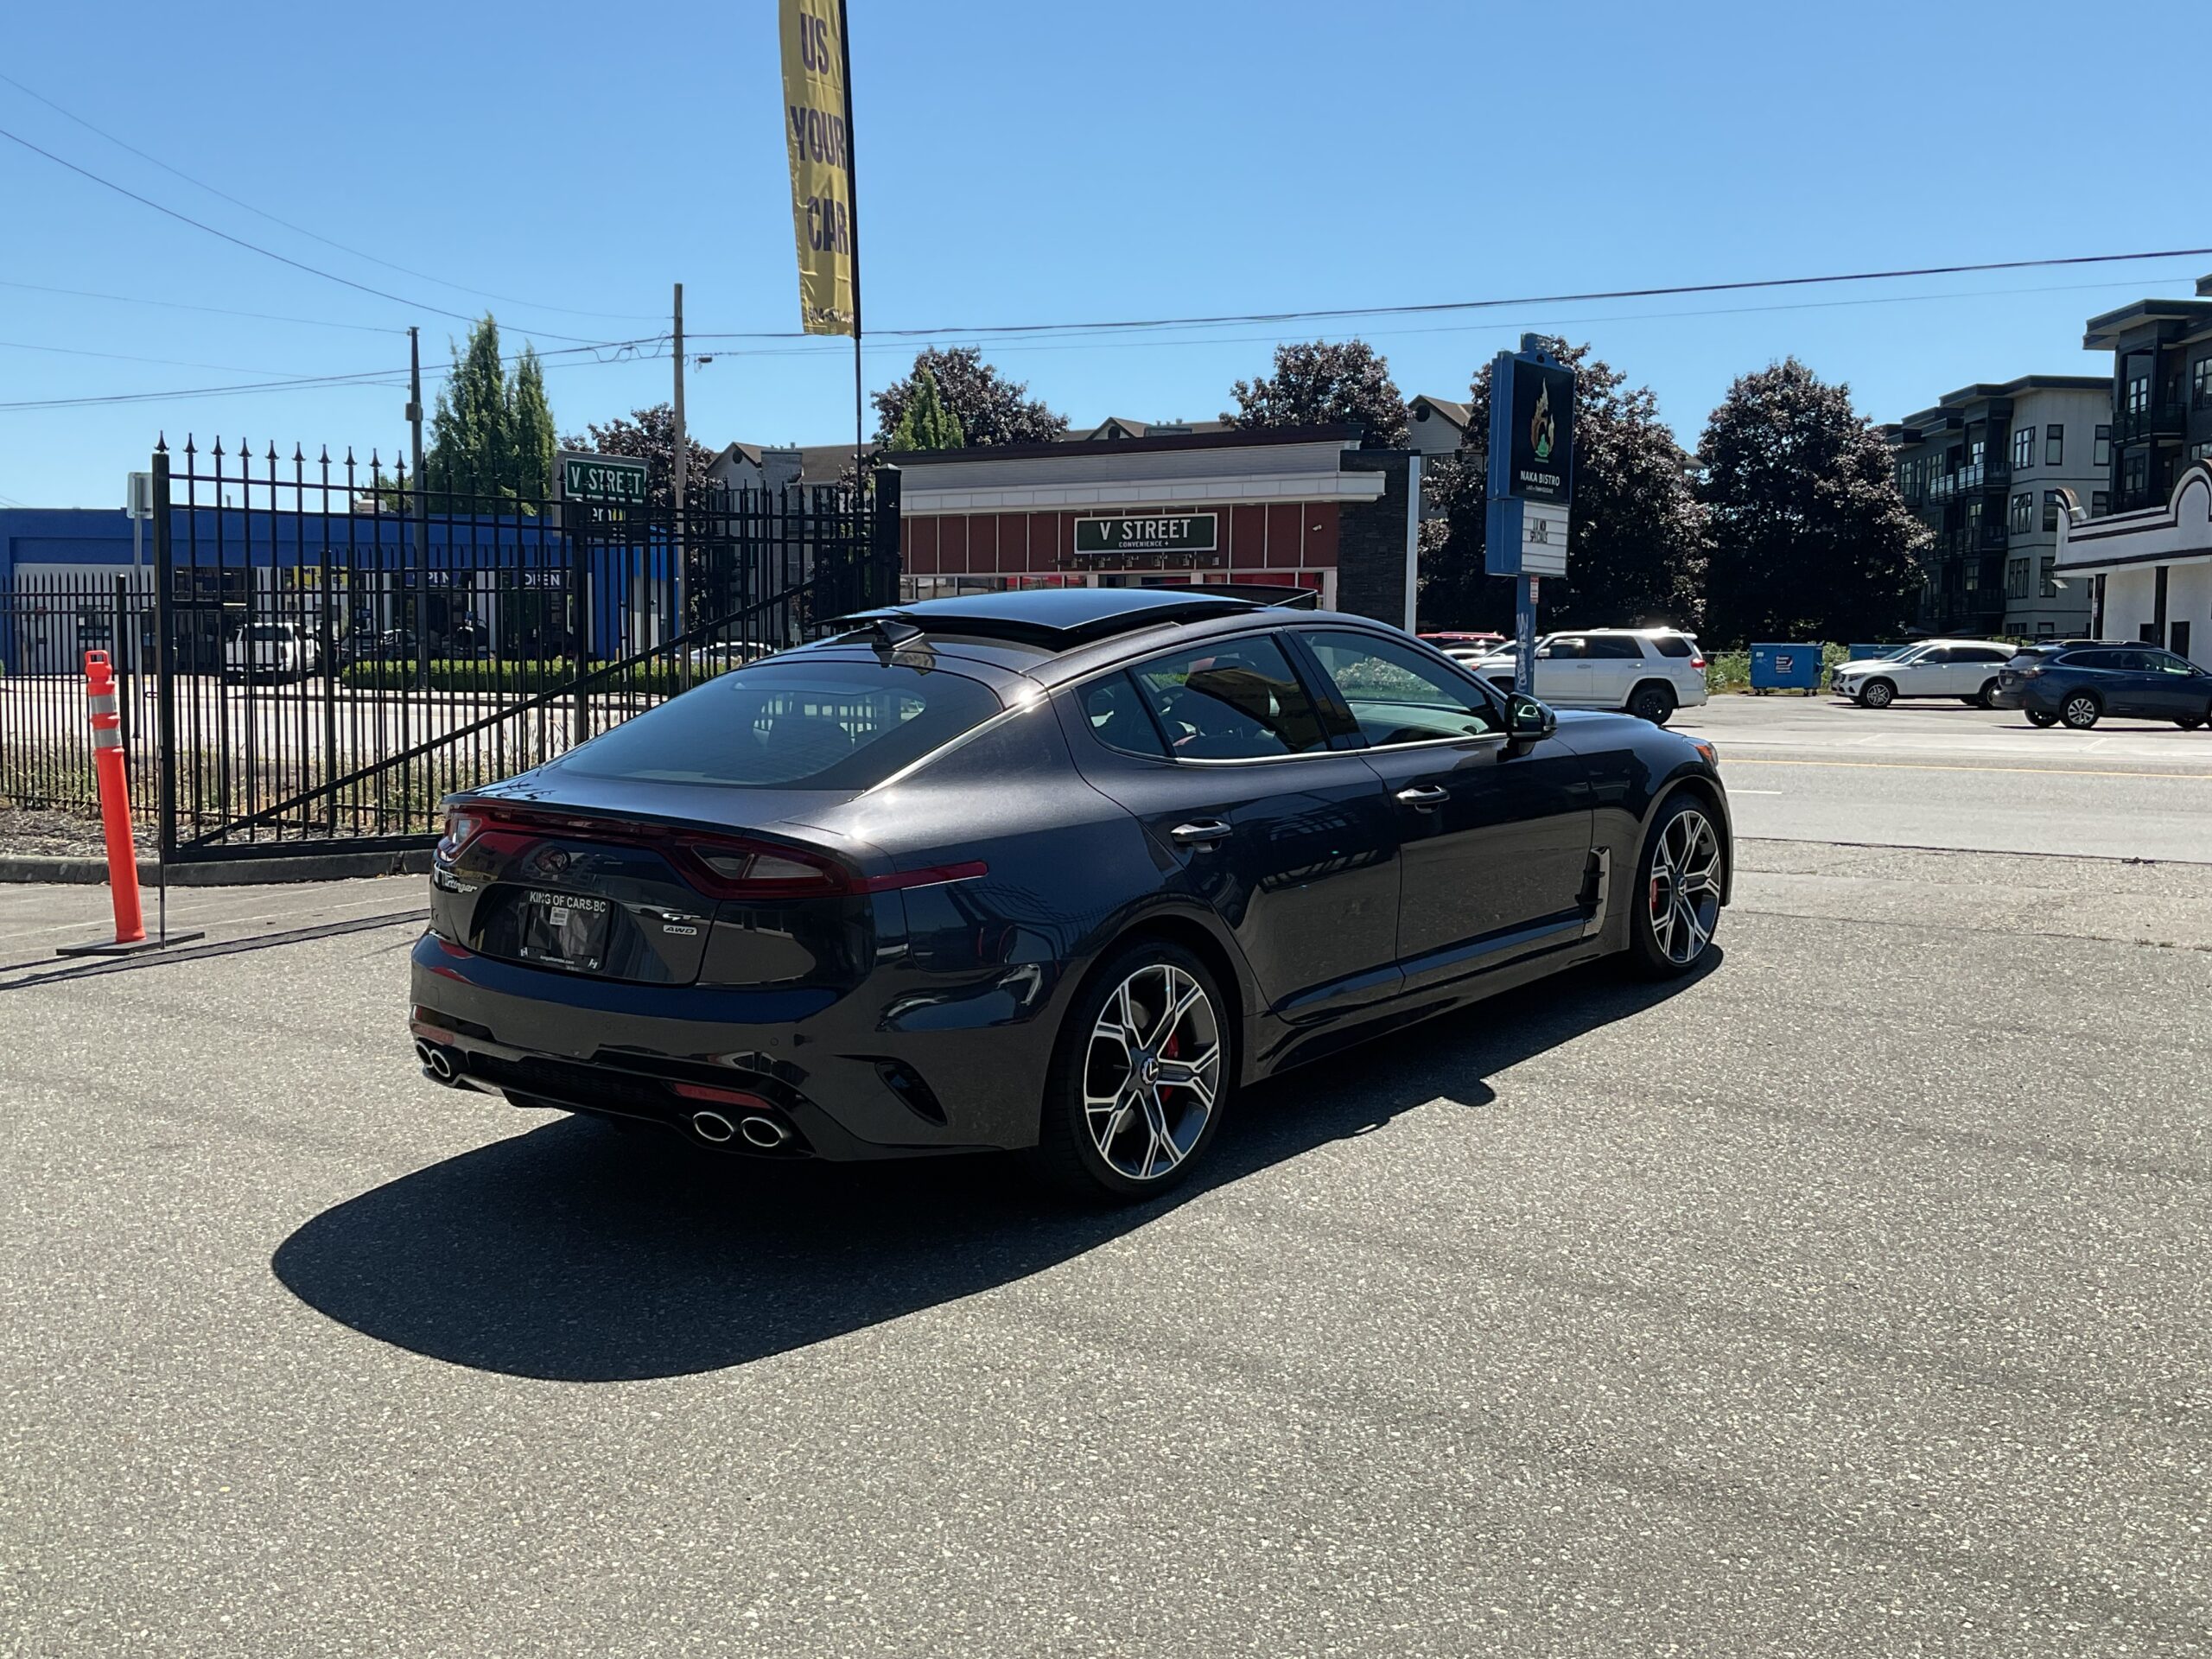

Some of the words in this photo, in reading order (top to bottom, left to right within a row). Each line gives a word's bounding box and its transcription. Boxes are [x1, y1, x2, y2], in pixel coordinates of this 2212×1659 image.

[800, 12, 830, 75] US
[790, 105, 847, 170] YOUR
[806, 195, 849, 256] CAR
[570, 467, 581, 488] V
[1520, 470, 1538, 483] NAKA
[1538, 473, 1560, 486] BISTRO
[1100, 522, 1111, 541] V
[1122, 519, 1191, 540] STREET
[529, 891, 551, 905] KING
[552, 894, 565, 906] OF
[594, 900, 607, 912] BC
